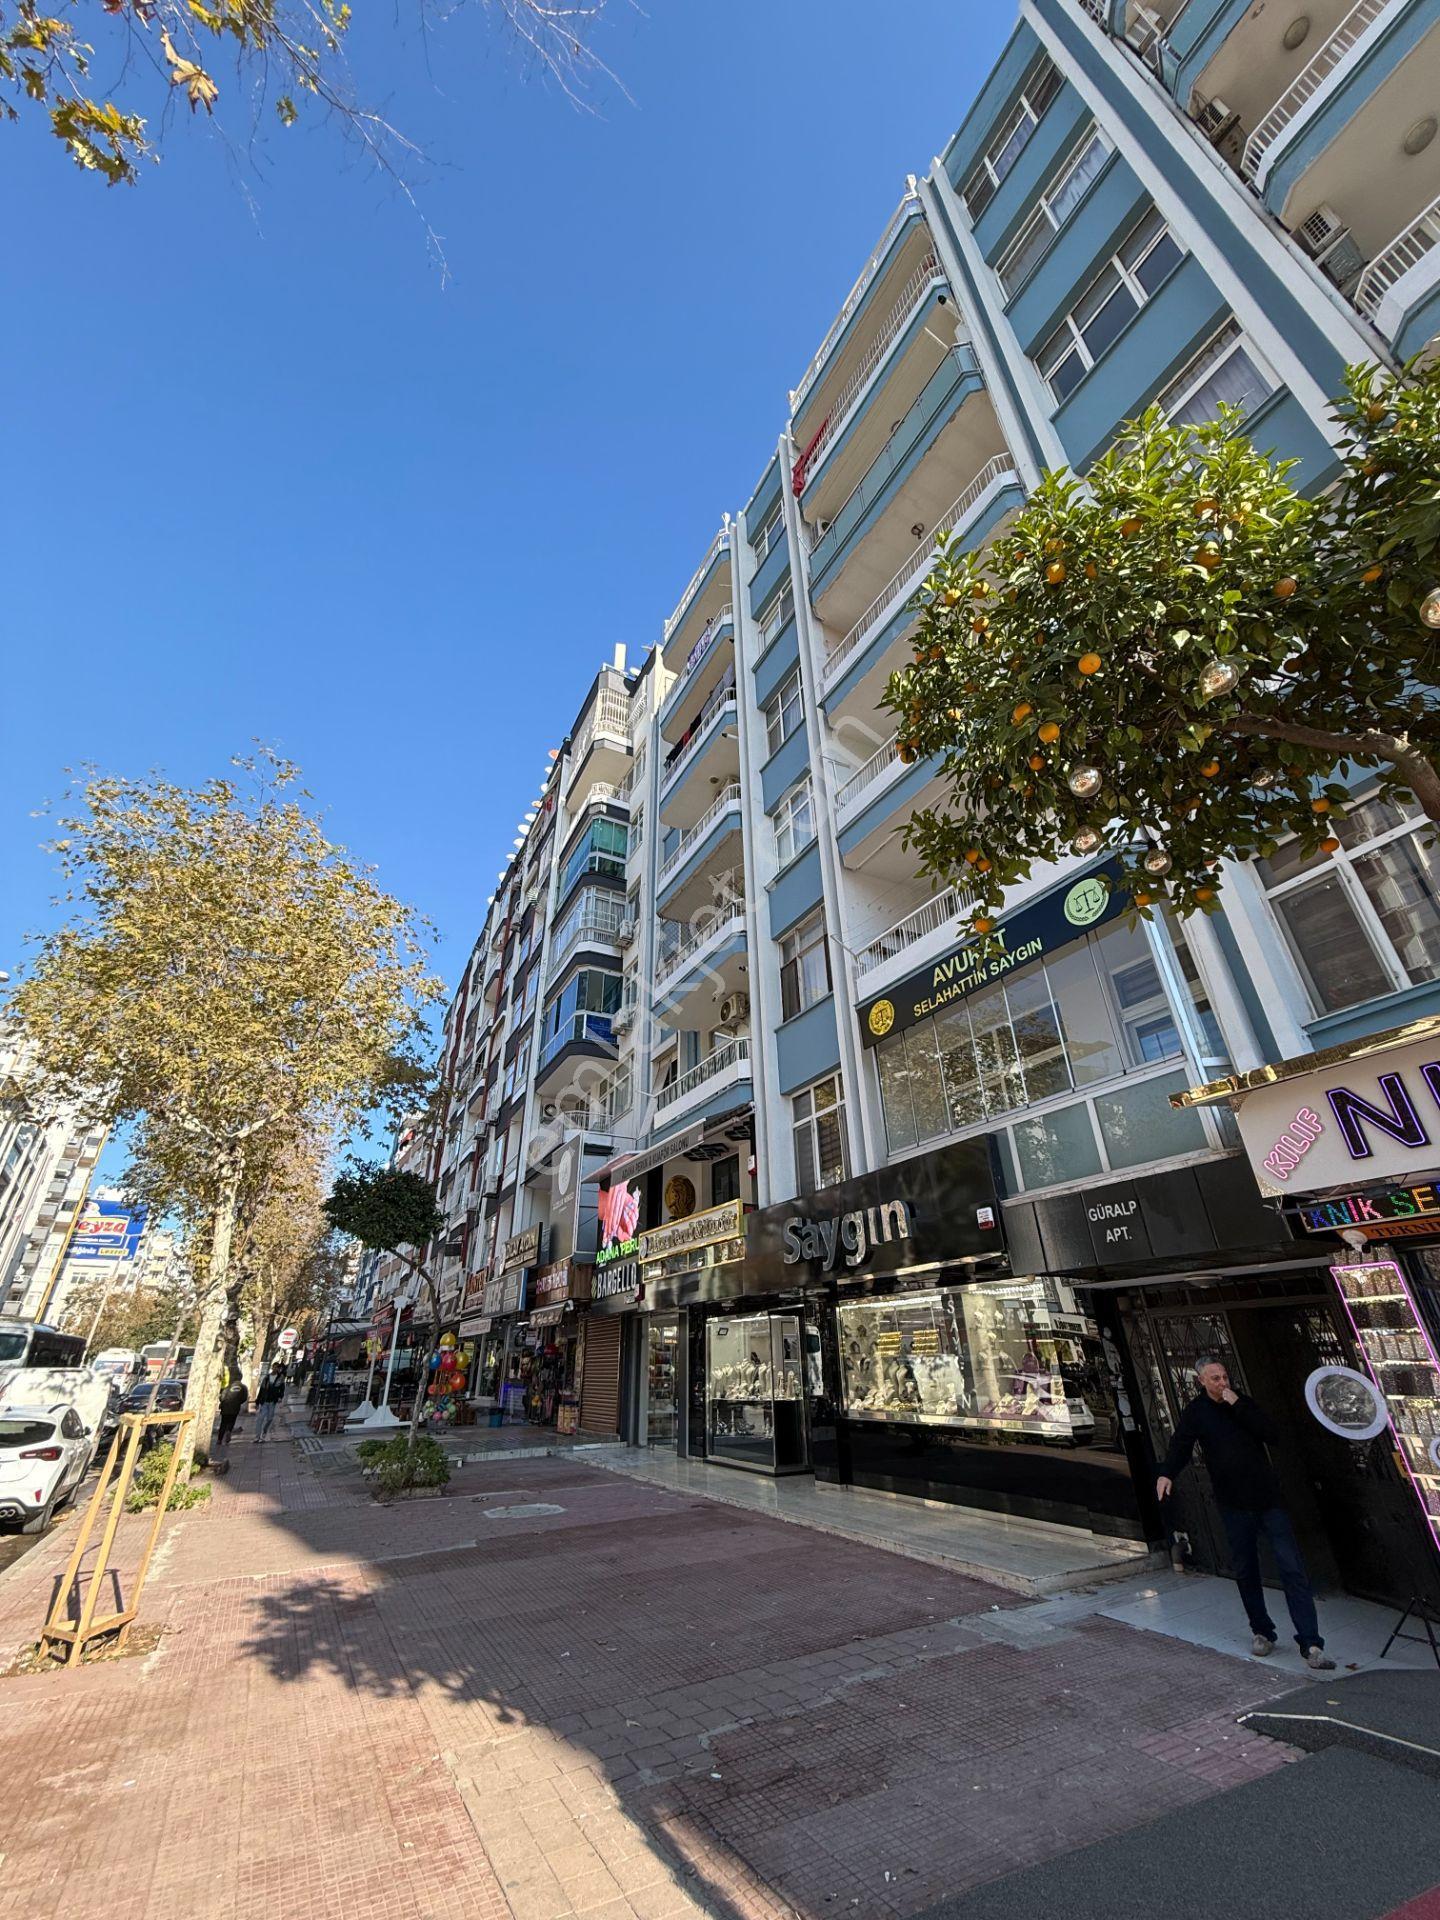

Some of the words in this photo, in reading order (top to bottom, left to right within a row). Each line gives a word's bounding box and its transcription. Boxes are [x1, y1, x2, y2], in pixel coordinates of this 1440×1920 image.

[913, 967, 988, 1017] SELAHATTİN
[989, 937, 1043, 977] SAYGIN
[1263, 1107, 1323, 1180] KILIF
[1088, 1201, 1137, 1222] GÜRALP
[1390, 1184, 1440, 1217] SE
[596, 1245, 620, 1264] ADANA
[620, 1237, 639, 1255] PERU
[783, 1200, 911, 1272] Saygın
[1106, 1226, 1133, 1243] APT.
[597, 1262, 637, 1300] BARGELLO
